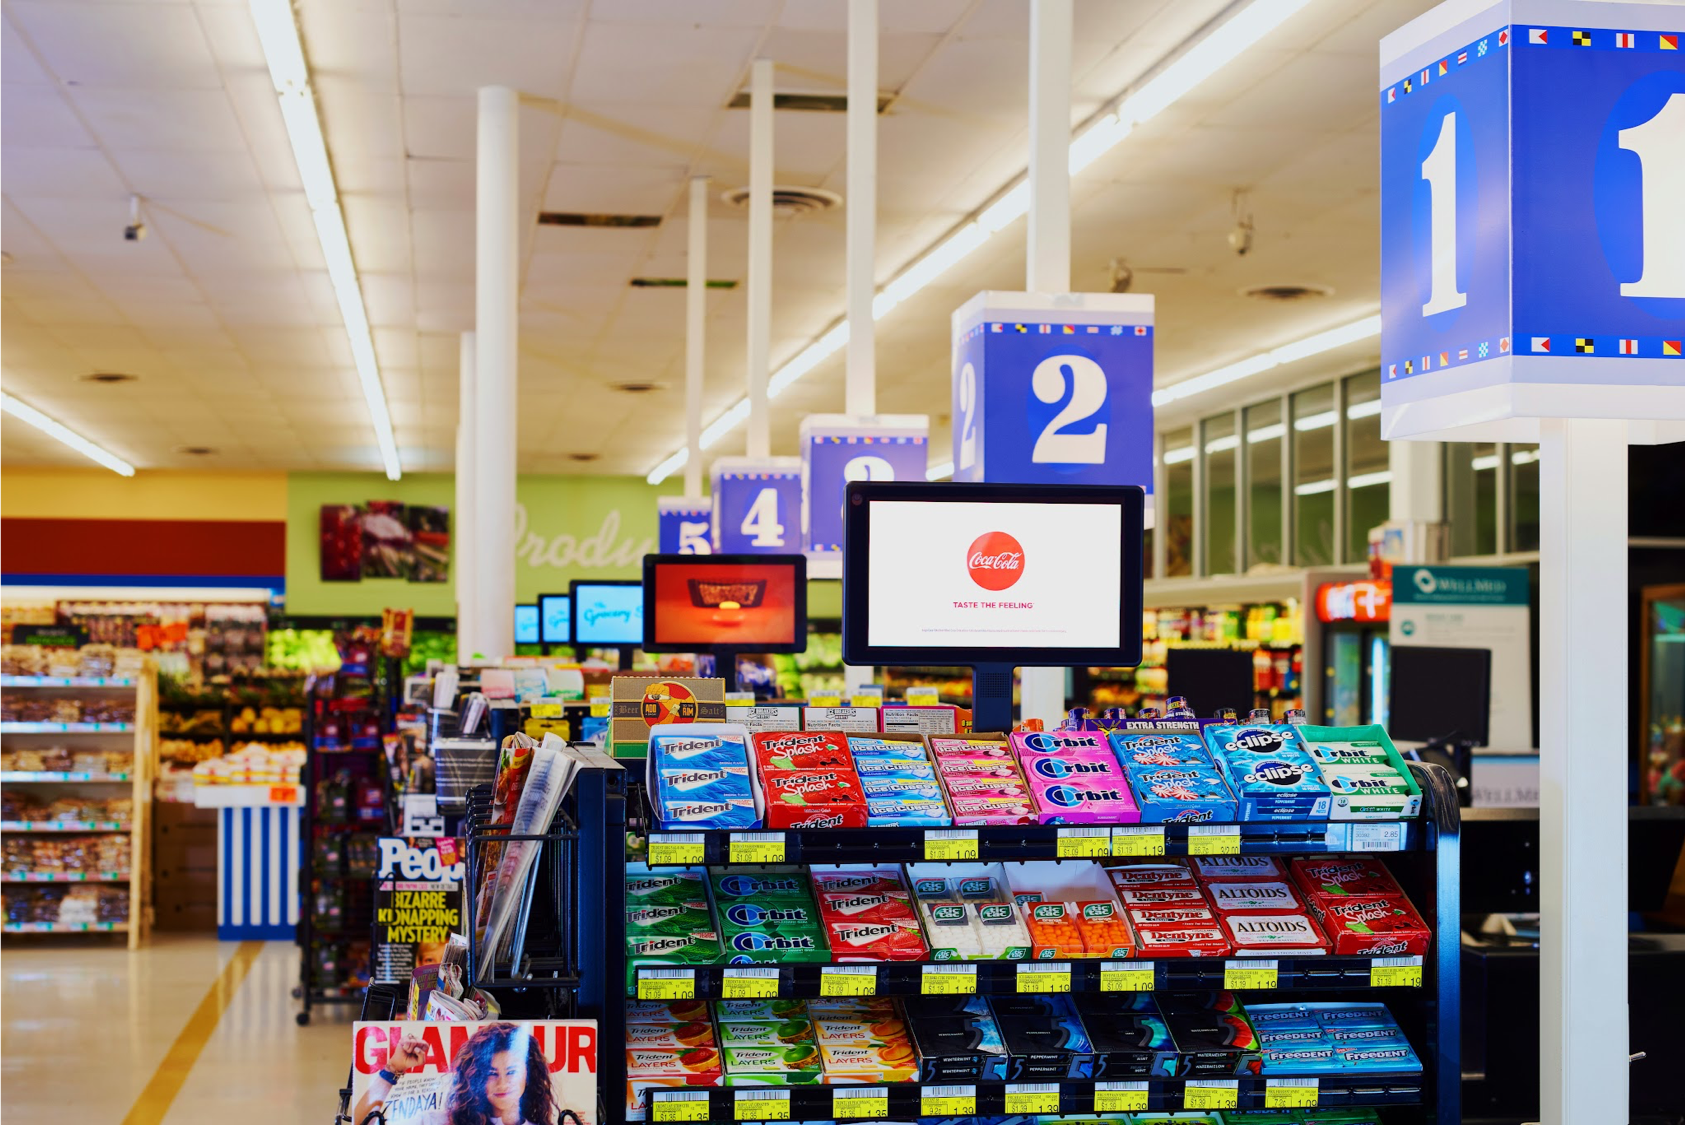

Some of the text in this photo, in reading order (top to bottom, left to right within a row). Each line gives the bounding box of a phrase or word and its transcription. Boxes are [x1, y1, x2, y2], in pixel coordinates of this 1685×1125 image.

[1618, 93, 1685, 298] 1
[1422, 112, 1467, 317] 1
[959, 361, 977, 471] 2
[1031, 354, 1108, 465] 2
[740, 488, 785, 547] 4
[678, 521, 712, 555] 5
[969, 552, 1022, 570] Coca-Cola
[700, 706, 720, 714] Salt
[1127, 722, 1200, 730] EXTRA STRENGTH
[659, 738, 722, 756] Trident
[762, 735, 826, 750] Trident
[1024, 732, 1100, 753] Orbit
[1121, 736, 1182, 751] Trident
[1224, 731, 1294, 752] eclipse
[774, 742, 824, 760] Splash
[1134, 744, 1182, 758] Splash
[1314, 746, 1370, 764] Orbit
[1035, 758, 1112, 779] Orbit
[1138, 770, 1200, 782] Trident
[1244, 763, 1314, 784] eclipse
[663, 770, 728, 786] Trident
[772, 773, 838, 788] Trident
[1152, 777, 1200, 793] Splash
[1332, 776, 1389, 794] Orbit
[784, 780, 836, 798] Splash
[1045, 784, 1123, 808] Orbit
[668, 802, 734, 818] Trident
[1318, 801, 1326, 810] 18
[1090, 848, 1109, 857] 109
[1201, 856, 1270, 867] ALTOIDS
[1122, 871, 1182, 880] Dentyne
[1306, 862, 1365, 878] Trident
[1320, 869, 1366, 887] Splash
[720, 875, 800, 896] Orbit
[821, 876, 880, 891] Trident
[391, 892, 446, 908] BIZARRE
[826, 894, 890, 910] Trident
[1132, 891, 1194, 900] Dentyne
[1219, 888, 1288, 899] ALTOIDS
[378, 908, 458, 926] KIDNAPPING
[626, 906, 686, 923] Trident
[726, 904, 808, 926] Orbit
[1141, 910, 1204, 920] Dentyne
[1330, 900, 1390, 916] Trident
[1344, 908, 1392, 925] Splash
[388, 926, 448, 943] MYSTERY
[835, 924, 898, 941] Trident
[1151, 930, 1214, 940] Dentyne
[1237, 921, 1307, 932] ALTOIDS
[628, 936, 696, 954] Trident
[732, 932, 815, 952] Orbit
[1402, 978, 1422, 987] 119
[964, 1018, 984, 1050] 5
[1051, 1017, 1070, 1048] 5
[1134, 1016, 1154, 1047] 5
[1217, 1015, 1236, 1046] 5
[355, 1026, 597, 1074] GLAUR
[926, 1061, 937, 1082] 5
[1011, 1059, 1025, 1080] 5
[1095, 1056, 1107, 1077] 5
[1180, 1056, 1193, 1076] 5
[380, 1092, 443, 1120] ZENDAYA!
